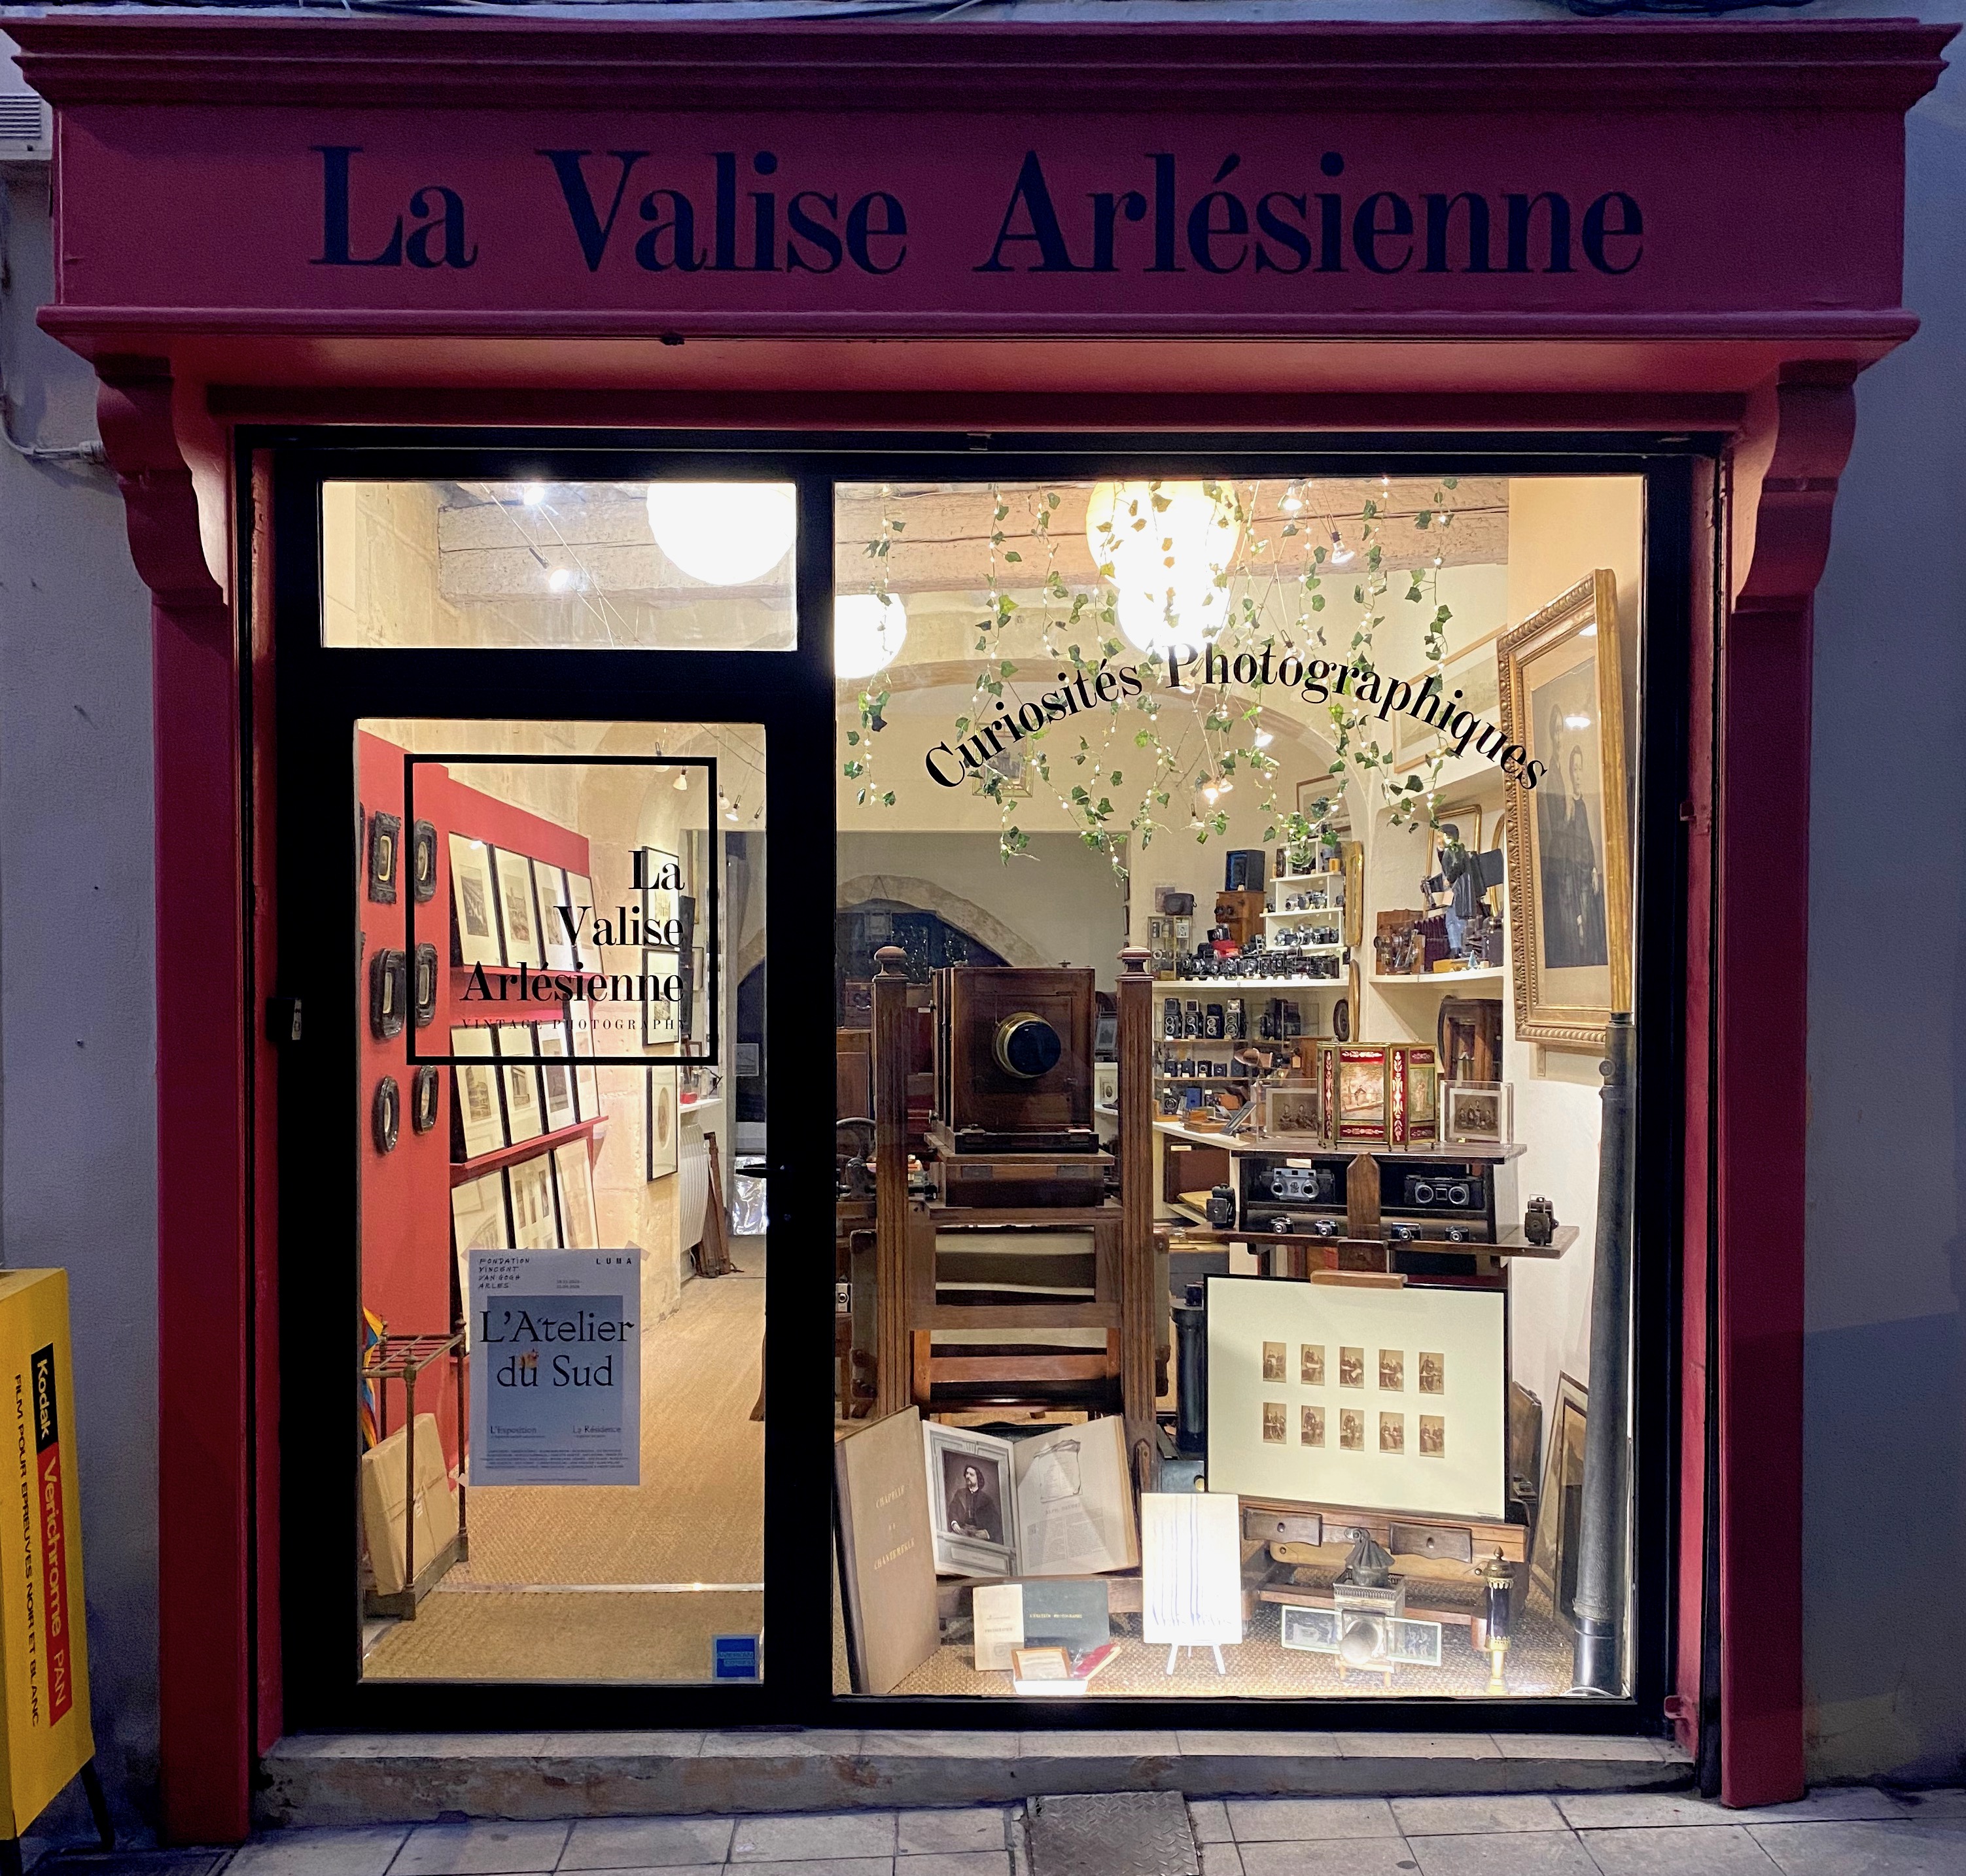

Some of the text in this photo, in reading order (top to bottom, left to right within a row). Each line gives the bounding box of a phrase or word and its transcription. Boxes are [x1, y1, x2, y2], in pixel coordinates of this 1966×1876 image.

[308, 145, 1644, 275] La Valise Arlésienne
[924, 644, 1549, 791] Curiosités Photographiques
[628, 850, 686, 891] La
[553, 905, 684, 947] Valise
[459, 960, 684, 1003] Arlésienne
[461, 1018, 687, 1030] VINTAGE PHOTOGRAPHY
[479, 1310, 635, 1343] L'Atelier
[497, 1353, 614, 1387] du Sud
[37, 1359, 51, 1440] Kodak
[15, 1374, 39, 1727] FILM POUR EPREUVES NOIR ET BLANC
[43, 1456, 66, 1707] Verichrome PAN
